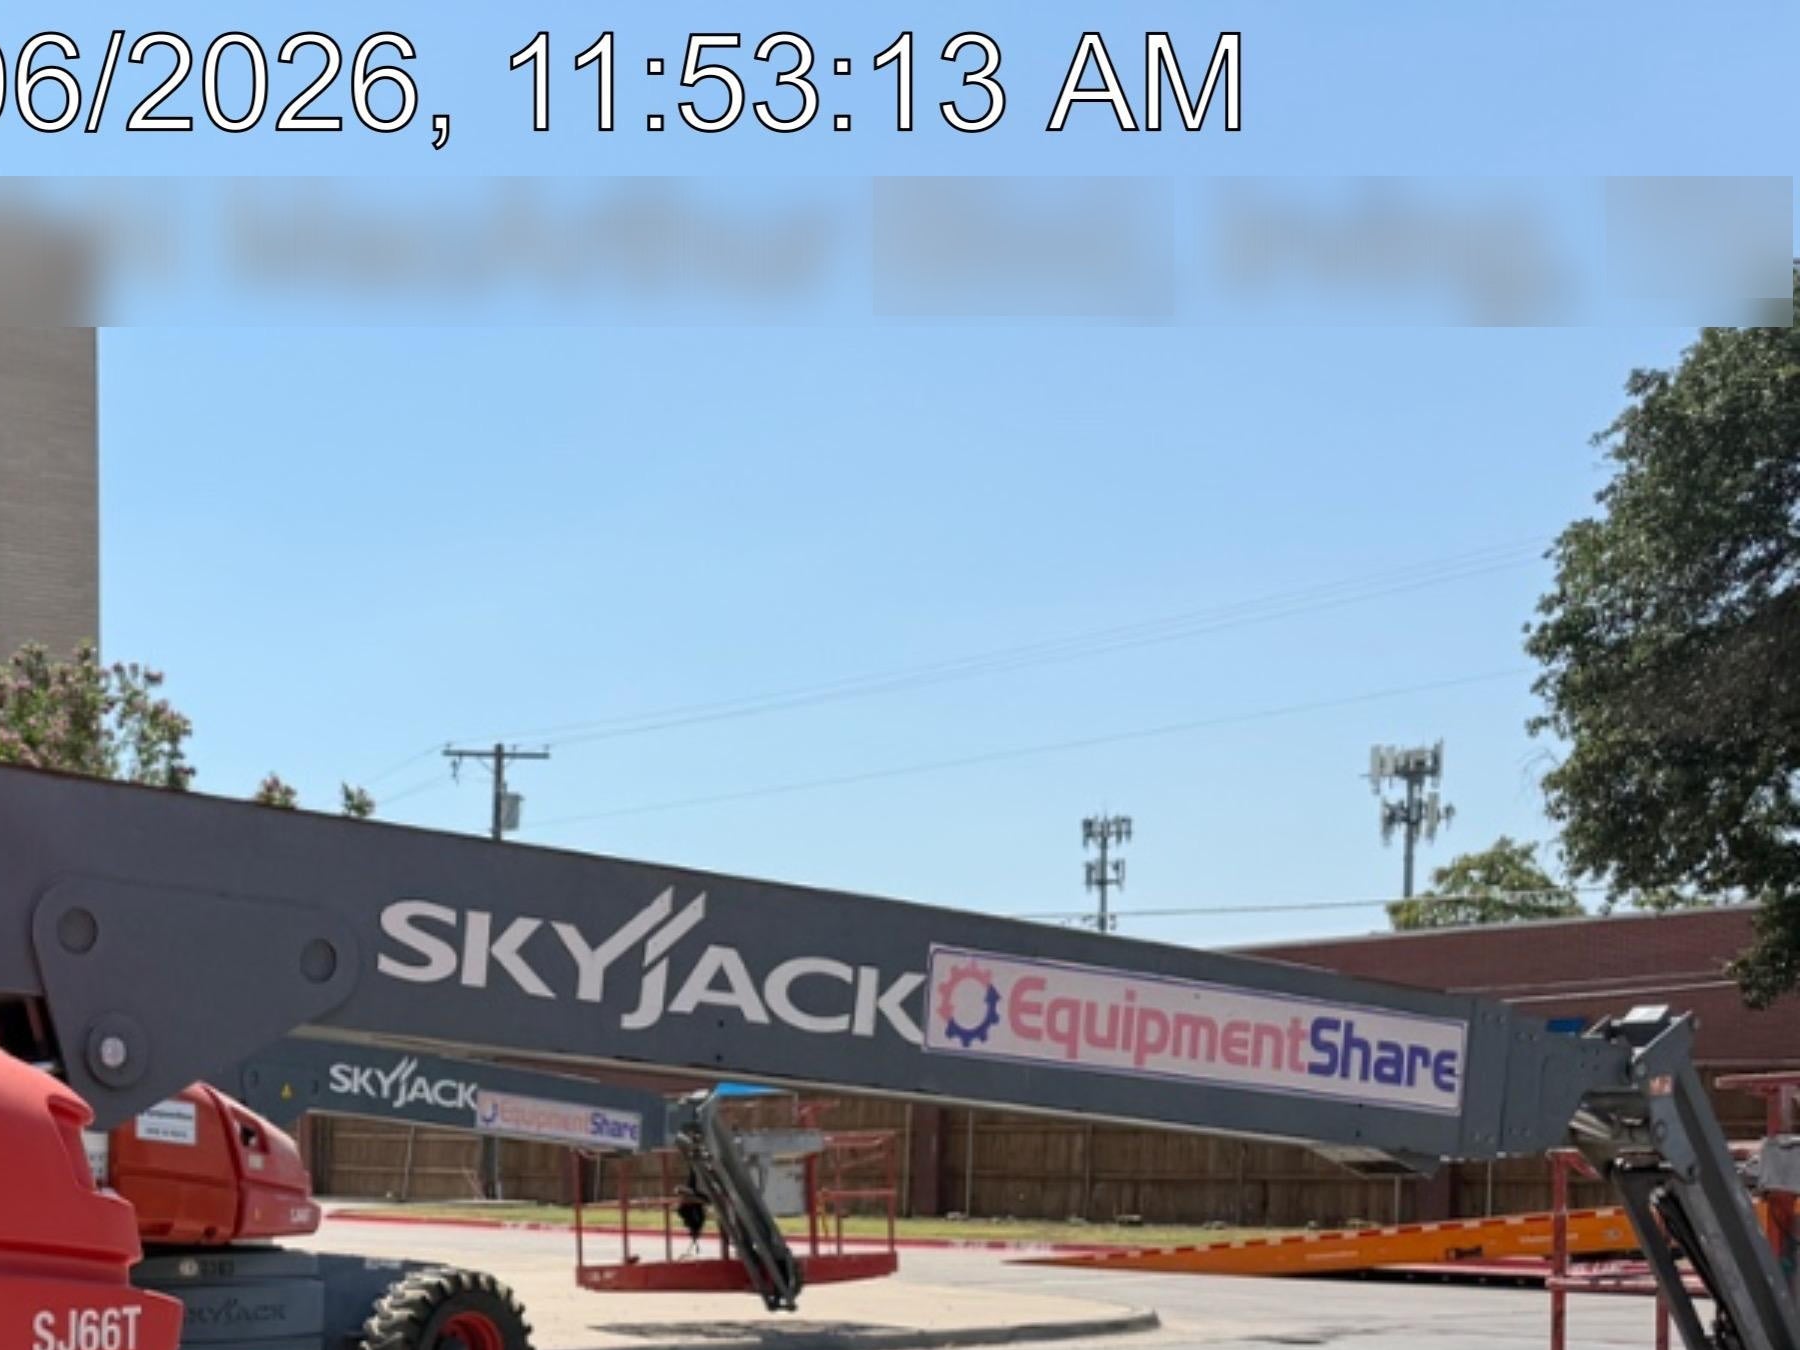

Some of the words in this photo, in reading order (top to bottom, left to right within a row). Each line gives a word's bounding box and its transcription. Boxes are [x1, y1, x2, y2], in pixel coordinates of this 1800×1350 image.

[377, 886, 925, 1045] SKYJACK
[329, 1055, 478, 1109] SKYJACK
[1008, 975, 1458, 1093] EquipmentShare
